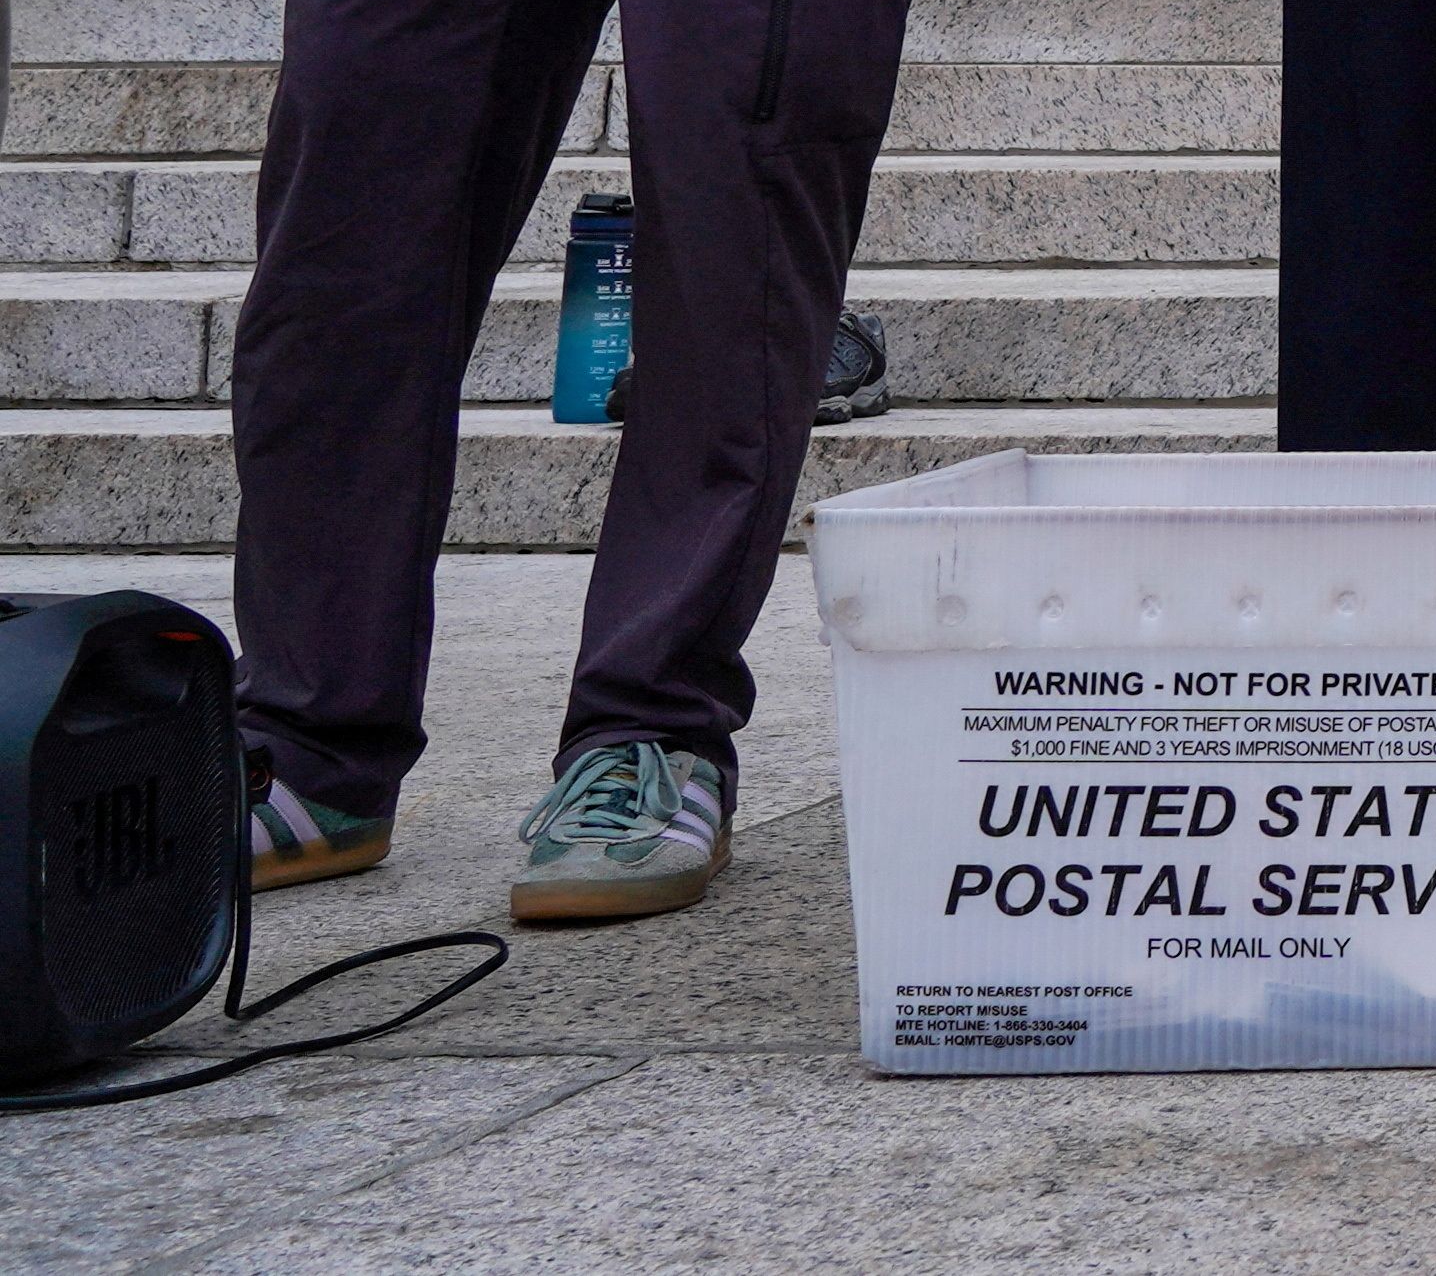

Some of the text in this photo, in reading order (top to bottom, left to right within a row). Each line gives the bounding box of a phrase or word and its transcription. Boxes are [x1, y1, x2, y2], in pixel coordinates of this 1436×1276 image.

[994, 671, 1144, 696] WARNING
[1173, 672, 1238, 697] NOT
[1247, 672, 1311, 697] FOR
[963, 715, 1052, 732] MAXIMUM
[1056, 715, 1137, 732] PENALTY
[1141, 716, 1178, 733] FOR
[1182, 716, 1241, 733] THEFT
[1243, 716, 1271, 733] OR
[1275, 716, 1344, 733] MISUSE
[1347, 716, 1374, 733] OF
[1010, 739, 1065, 758] $1,000
[1069, 740, 1110, 757] FINE
[1112, 740, 1152, 757] AND
[1155, 740, 1166, 757] 3
[1169, 740, 1231, 757] YEARS
[1235, 740, 1375, 757] IMPRISONMENT
[1377, 740, 1404, 760] (18
[978, 784, 1237, 838] UNITED
[944, 863, 1228, 917] POSTAL
[1147, 937, 1351, 959] FOR MAIL ONLY
[896, 985, 1134, 998] RETURN TO NEAREST POST OFFICE
[896, 1004, 1028, 1017] TO REPORT MISUSE
[895, 1019, 1089, 1032] MTE HOTLINE: 1-866-330-3404
[895, 1034, 1077, 1049] EMAIL: HQMTE@USPS.GOV
